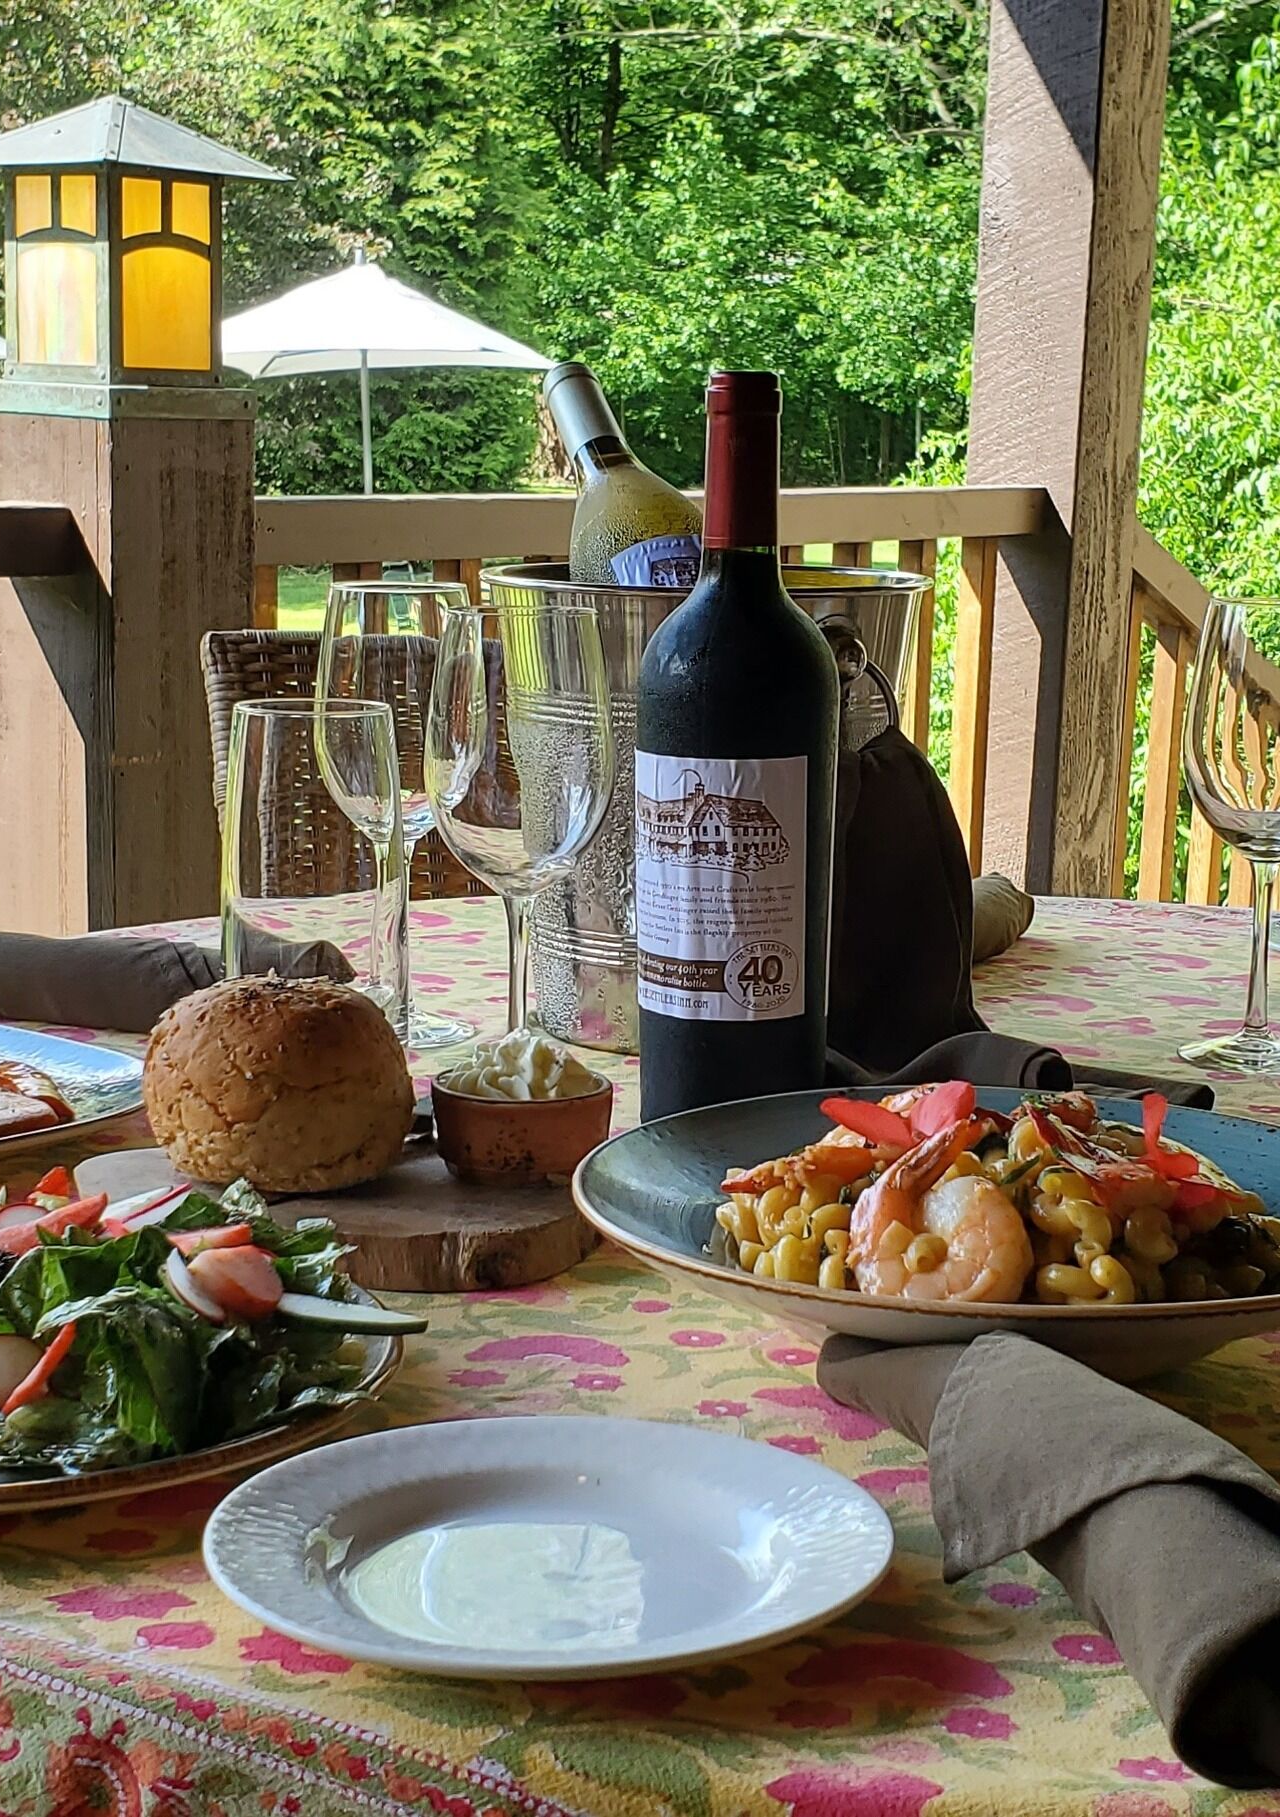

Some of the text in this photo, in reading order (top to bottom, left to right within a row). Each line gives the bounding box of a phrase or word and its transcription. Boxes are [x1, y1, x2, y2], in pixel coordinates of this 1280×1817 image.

[717, 885, 738, 893] Crafts
[714, 896, 738, 904] friends
[704, 928, 729, 938] flagship
[732, 930, 761, 938] property
[732, 952, 745, 964] THE
[746, 943, 780, 954] SETTLERS
[666, 963, 678, 971] our
[678, 964, 697, 975] 40th
[699, 967, 718, 978] year
[738, 956, 783, 986] 40
[683, 976, 709, 988] bottle.
[738, 982, 791, 998] YEARS
